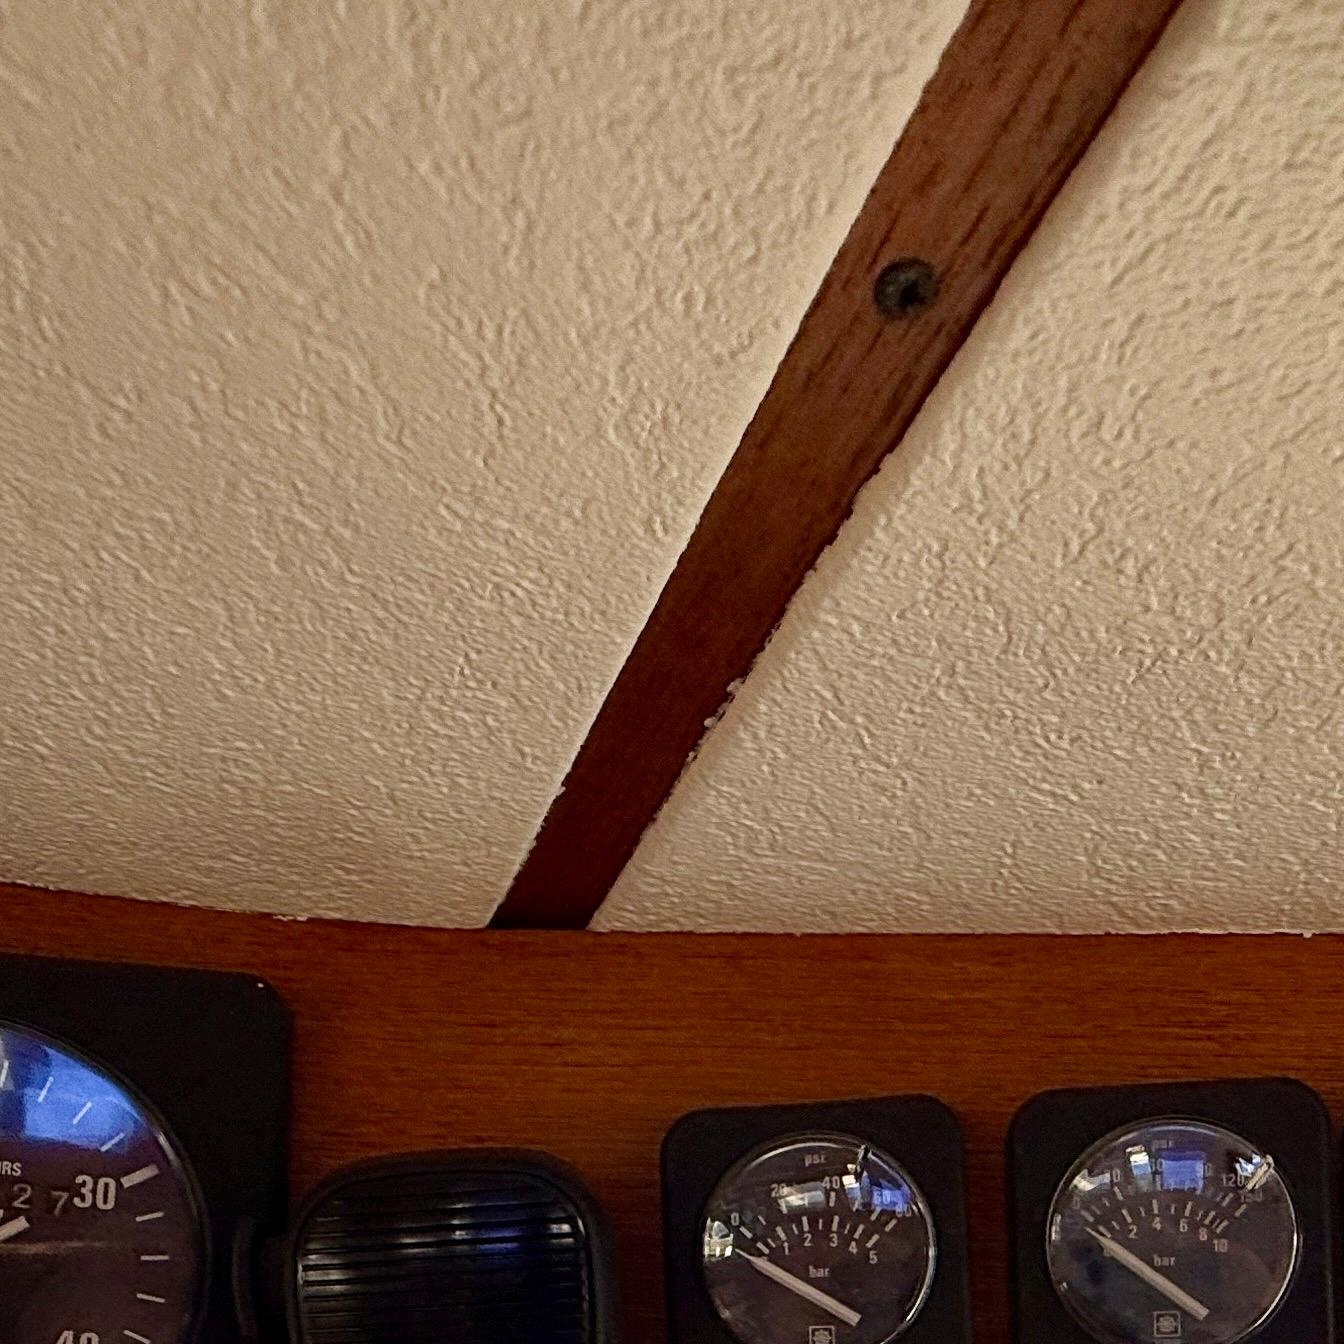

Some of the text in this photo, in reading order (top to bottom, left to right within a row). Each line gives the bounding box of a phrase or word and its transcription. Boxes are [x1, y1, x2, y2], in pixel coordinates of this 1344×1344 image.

[822, 1176, 841, 1189] 40
[73, 1175, 117, 1210] 30
[873, 1190, 891, 1204] 60
[730, 1212, 740, 1226] 0
[1152, 1216, 1162, 1231] 4
[1179, 1219, 1188, 1232] 6
[1128, 1225, 1138, 1239] 2
[803, 1234, 813, 1247] 2
[829, 1233, 839, 1247] 3
[1212, 1239, 1228, 1252] 10
[783, 1242, 790, 1256] 1
[848, 1241, 858, 1255] 4
[868, 1250, 878, 1265] 5
[1153, 1255, 1176, 1267] bar
[808, 1265, 831, 1278] bar
